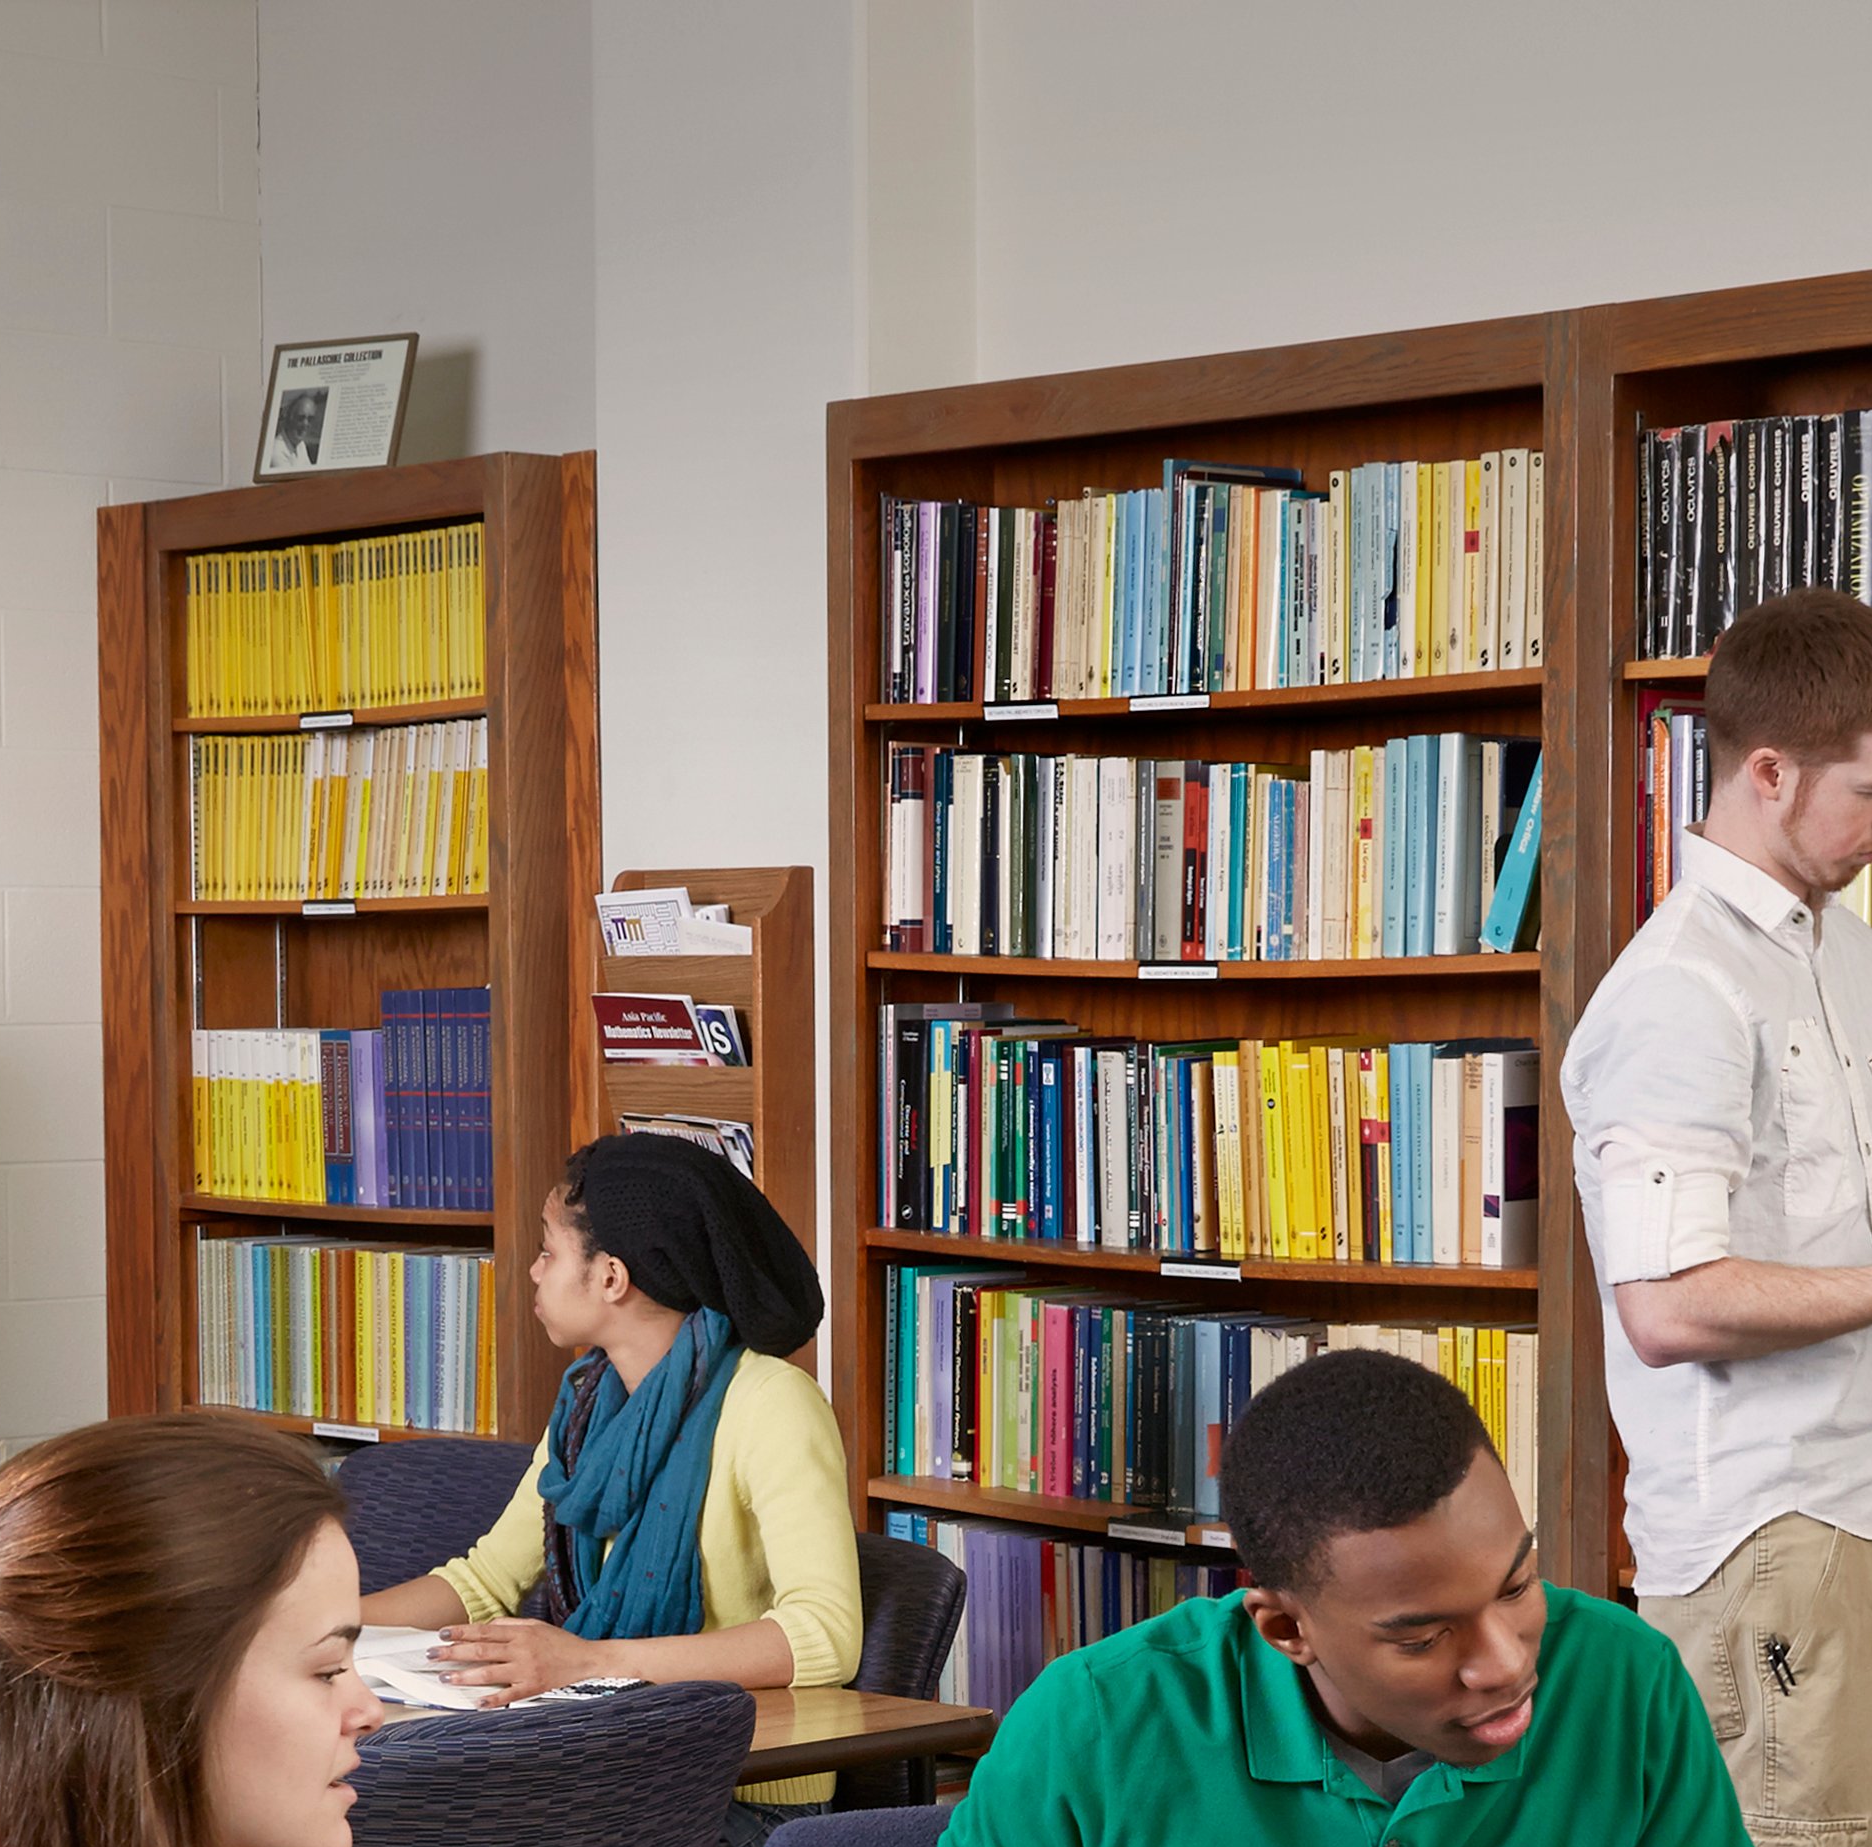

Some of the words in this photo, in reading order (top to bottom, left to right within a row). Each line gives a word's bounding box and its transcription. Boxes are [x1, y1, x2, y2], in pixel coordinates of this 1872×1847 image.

[622, 1011, 639, 1022] Asia
[641, 1011, 667, 1023] Pacific
[604, 1025, 652, 1040] Mathematics
[700, 1020, 732, 1054] IS
